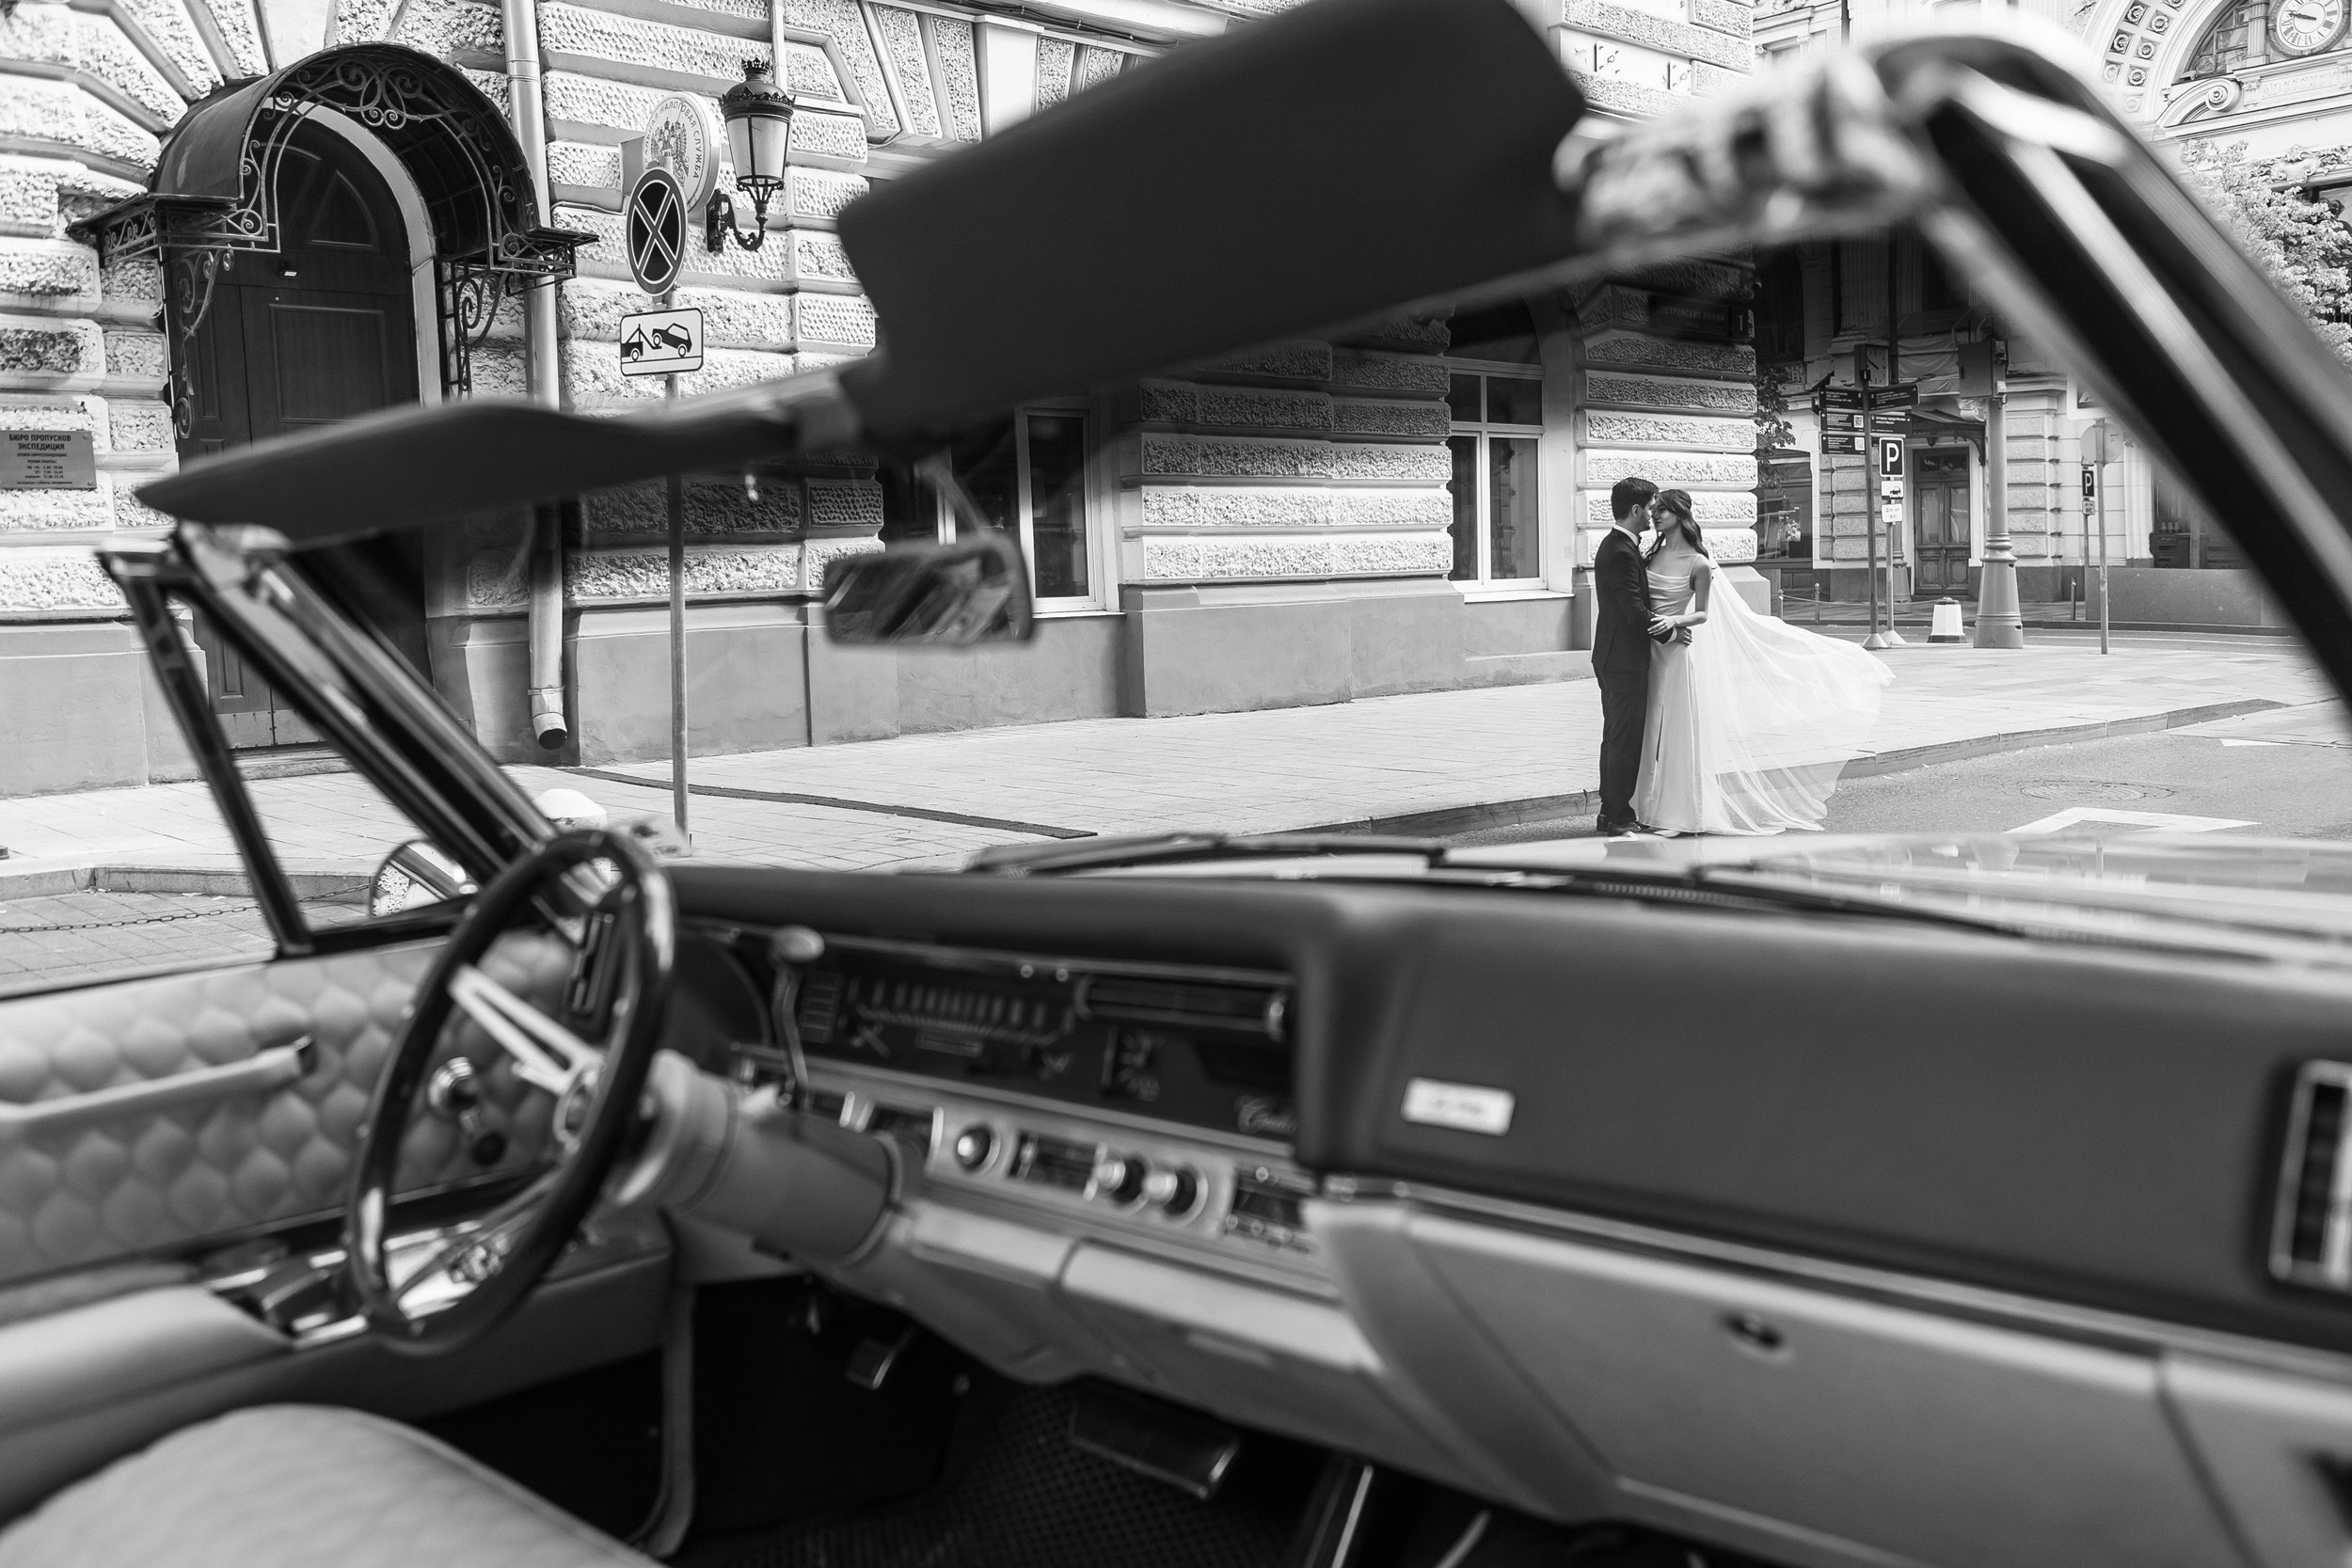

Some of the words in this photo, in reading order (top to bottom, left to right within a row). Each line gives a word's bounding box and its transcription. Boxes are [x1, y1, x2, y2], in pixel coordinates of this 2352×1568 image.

[660, 101, 697, 128] НАЛОГОВАЯ
[692, 130, 702, 179] СЛУЖБА
[30, 434, 72, 442] ПРОПУСКОВ
[1886, 442, 1899, 472] P
[2085, 473, 2092, 494] P
